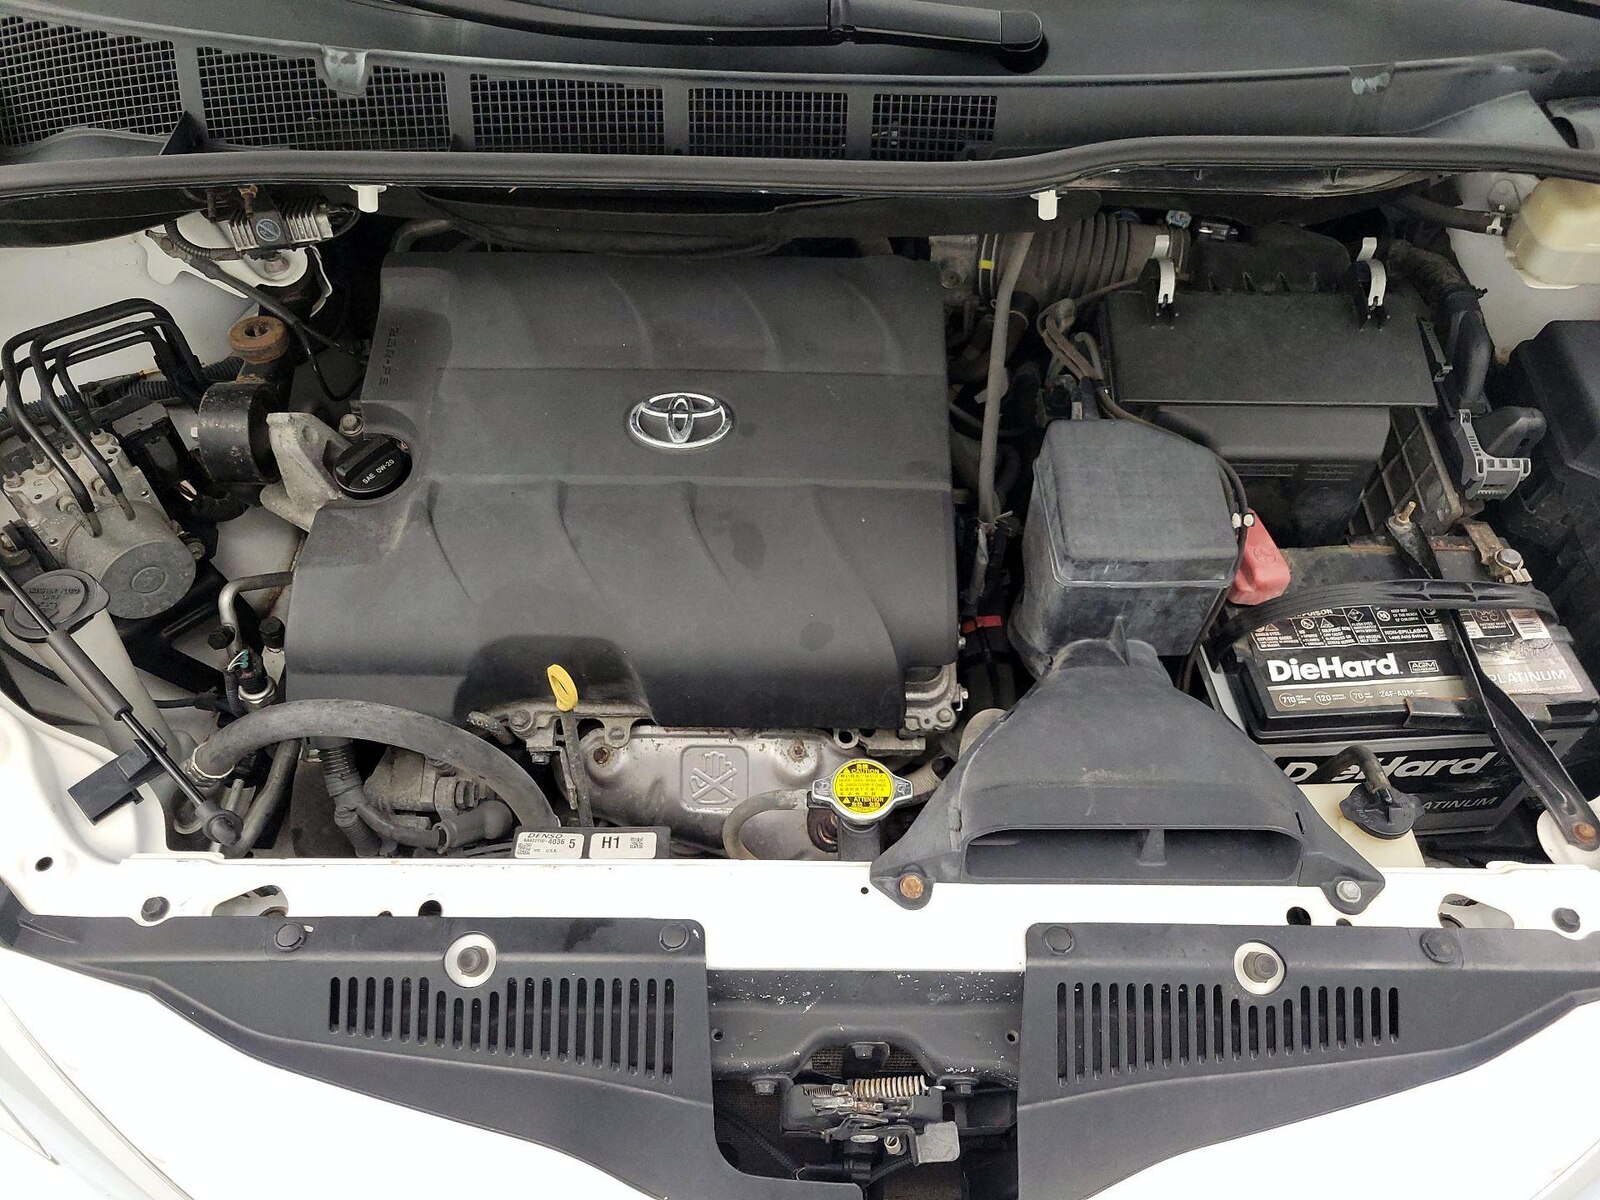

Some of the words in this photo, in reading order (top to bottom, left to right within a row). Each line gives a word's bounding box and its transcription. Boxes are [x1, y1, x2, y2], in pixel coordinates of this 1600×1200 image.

[362, 472, 376, 484] SAE
[375, 459, 395, 474] 0W-20
[1488, 669, 1568, 684] PLATINUM
[1282, 695, 1297, 704] 710
[1316, 694, 1332, 702] 120
[1352, 692, 1364, 700] 70
[1422, 796, 1499, 810] ATINUM
[568, 838, 576, 849] 5
[601, 836, 620, 849] H1
